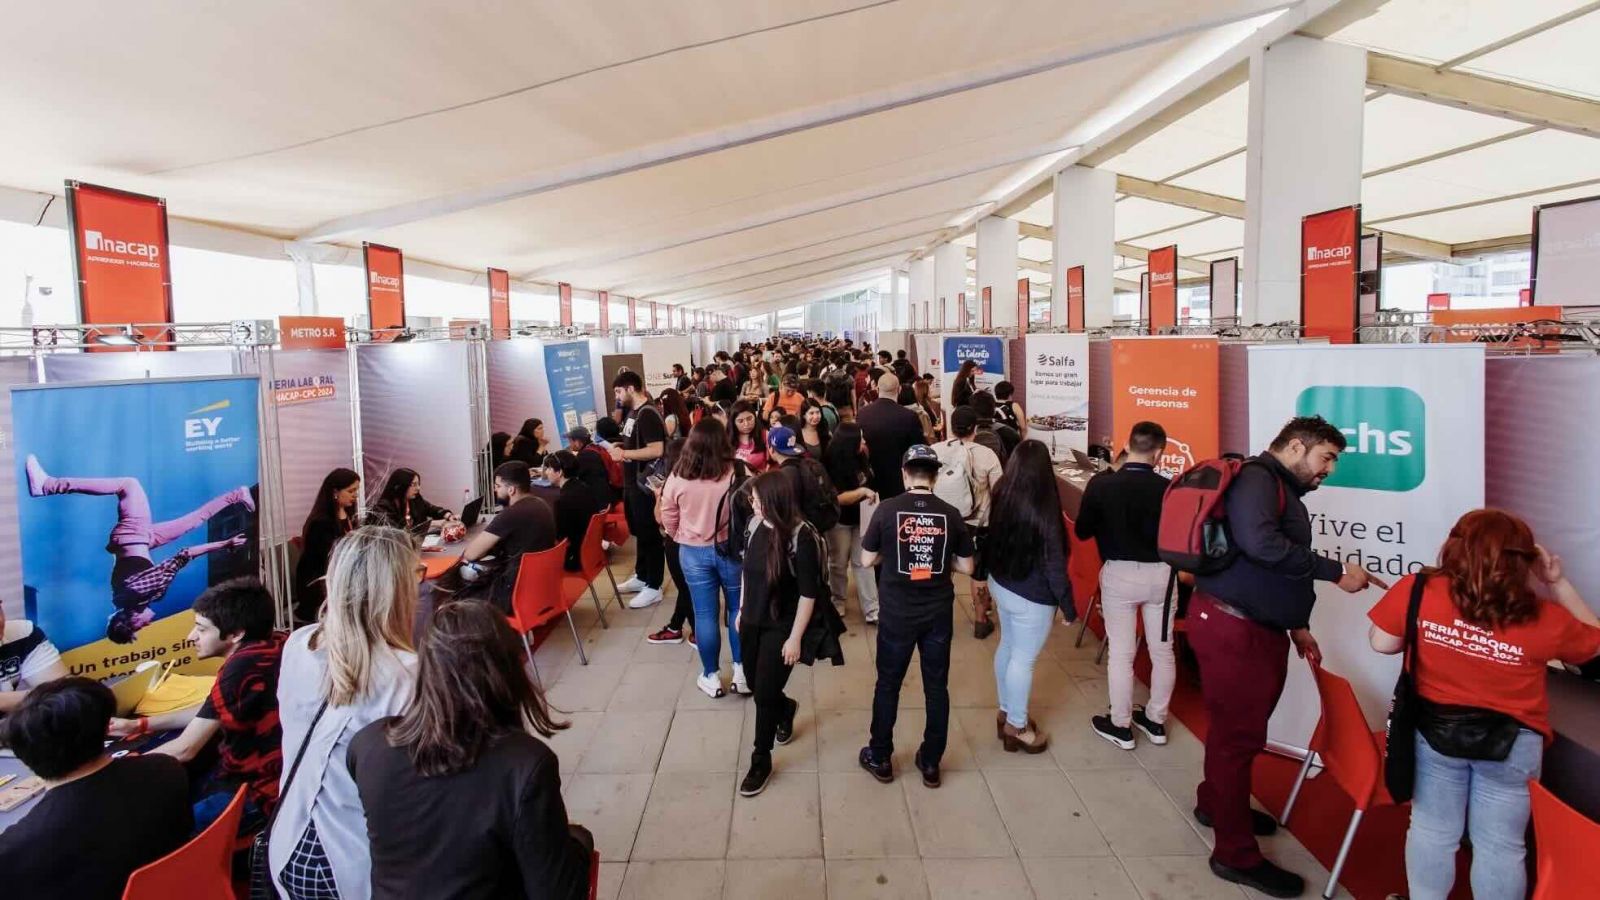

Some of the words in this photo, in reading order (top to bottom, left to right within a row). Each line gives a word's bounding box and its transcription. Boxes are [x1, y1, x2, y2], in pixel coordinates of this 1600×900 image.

[291, 327, 321, 338] METRO
[1049, 355, 1075, 366] Salfa
[298, 376, 334, 388] LABORAL
[1129, 385, 1179, 396] Gerencia
[1181, 387, 1197, 397] de
[1136, 398, 1189, 409] Personas
[185, 416, 223, 438] EY
[1340, 422, 1412, 456] chs
[1160, 453, 1186, 465] nta
[909, 516, 934, 526] PARK
[1376, 521, 1406, 544] el
[909, 535, 935, 544] FROM
[909, 544, 933, 553] DUSK
[1422, 620, 1460, 638] FERIA
[1462, 630, 1524, 656] LABORAL
[1424, 630, 1490, 655] INACAP-CPC
[1492, 649, 1521, 662] 2024
[69, 663, 97, 676] Un
[102, 646, 167, 669] trabajo
[171, 638, 197, 652] sin
